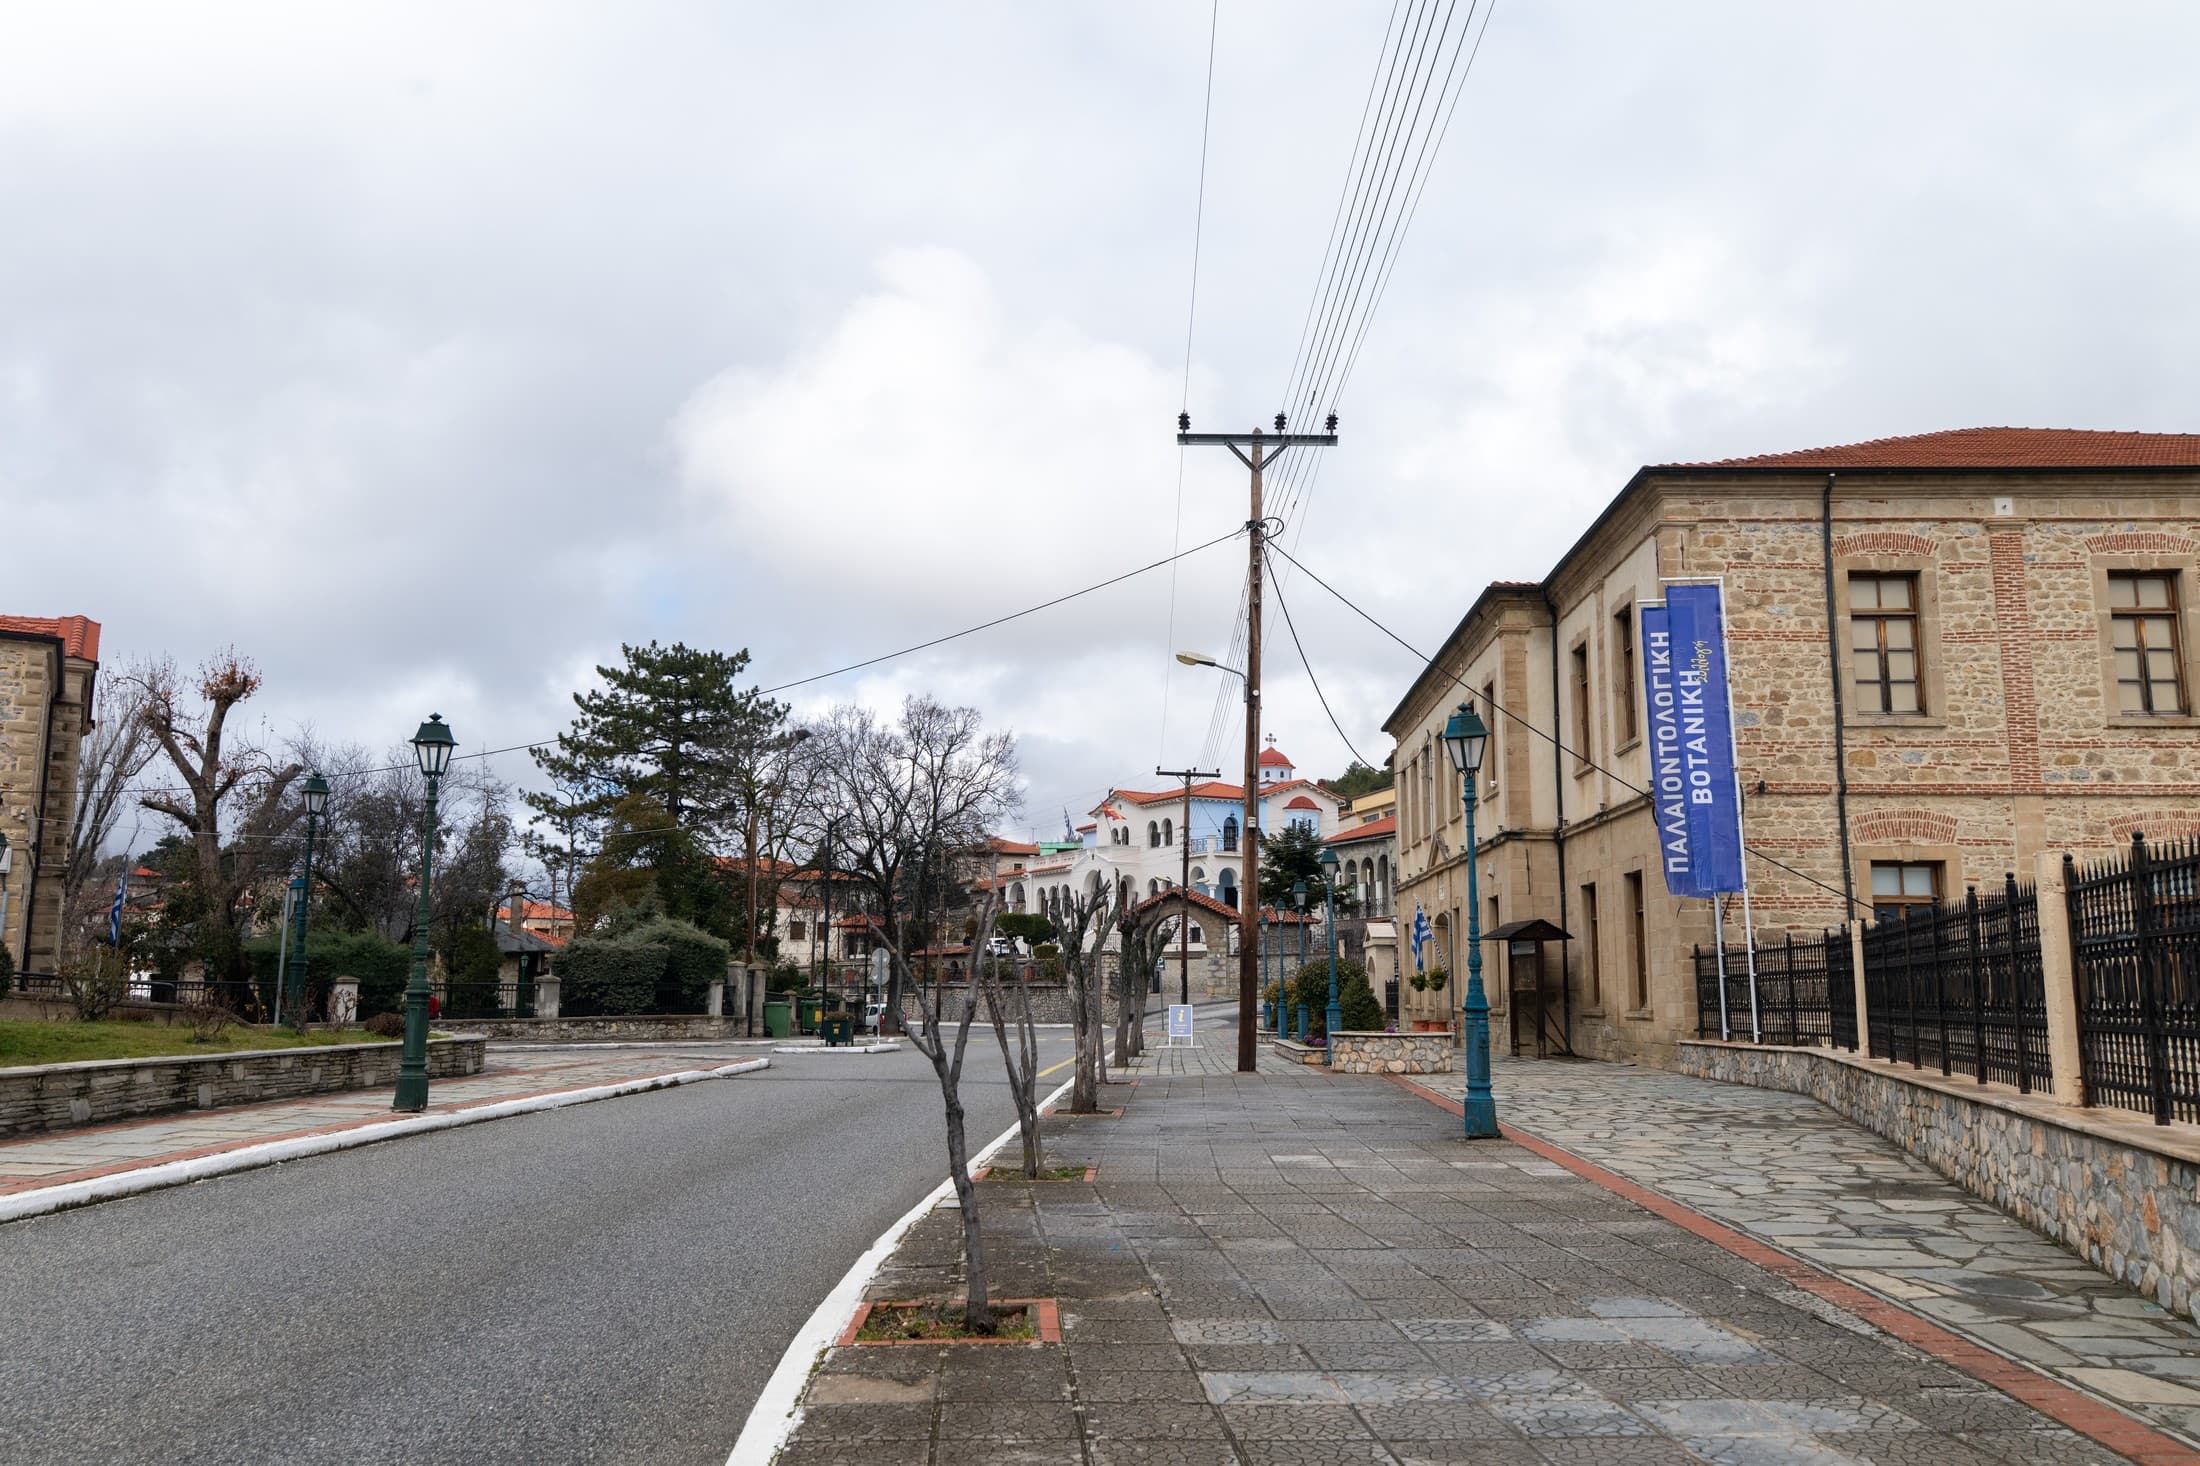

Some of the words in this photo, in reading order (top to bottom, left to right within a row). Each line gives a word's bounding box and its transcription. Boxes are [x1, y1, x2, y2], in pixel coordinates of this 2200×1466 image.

[1649, 631, 1689, 873] ΠΑΛΑΙΟΝΤΟΛΟΓΙΚΗ
[1679, 670, 1713, 805] ΒΟΤΑΝΙΚΗ
[1157, 957, 1163, 966] P
